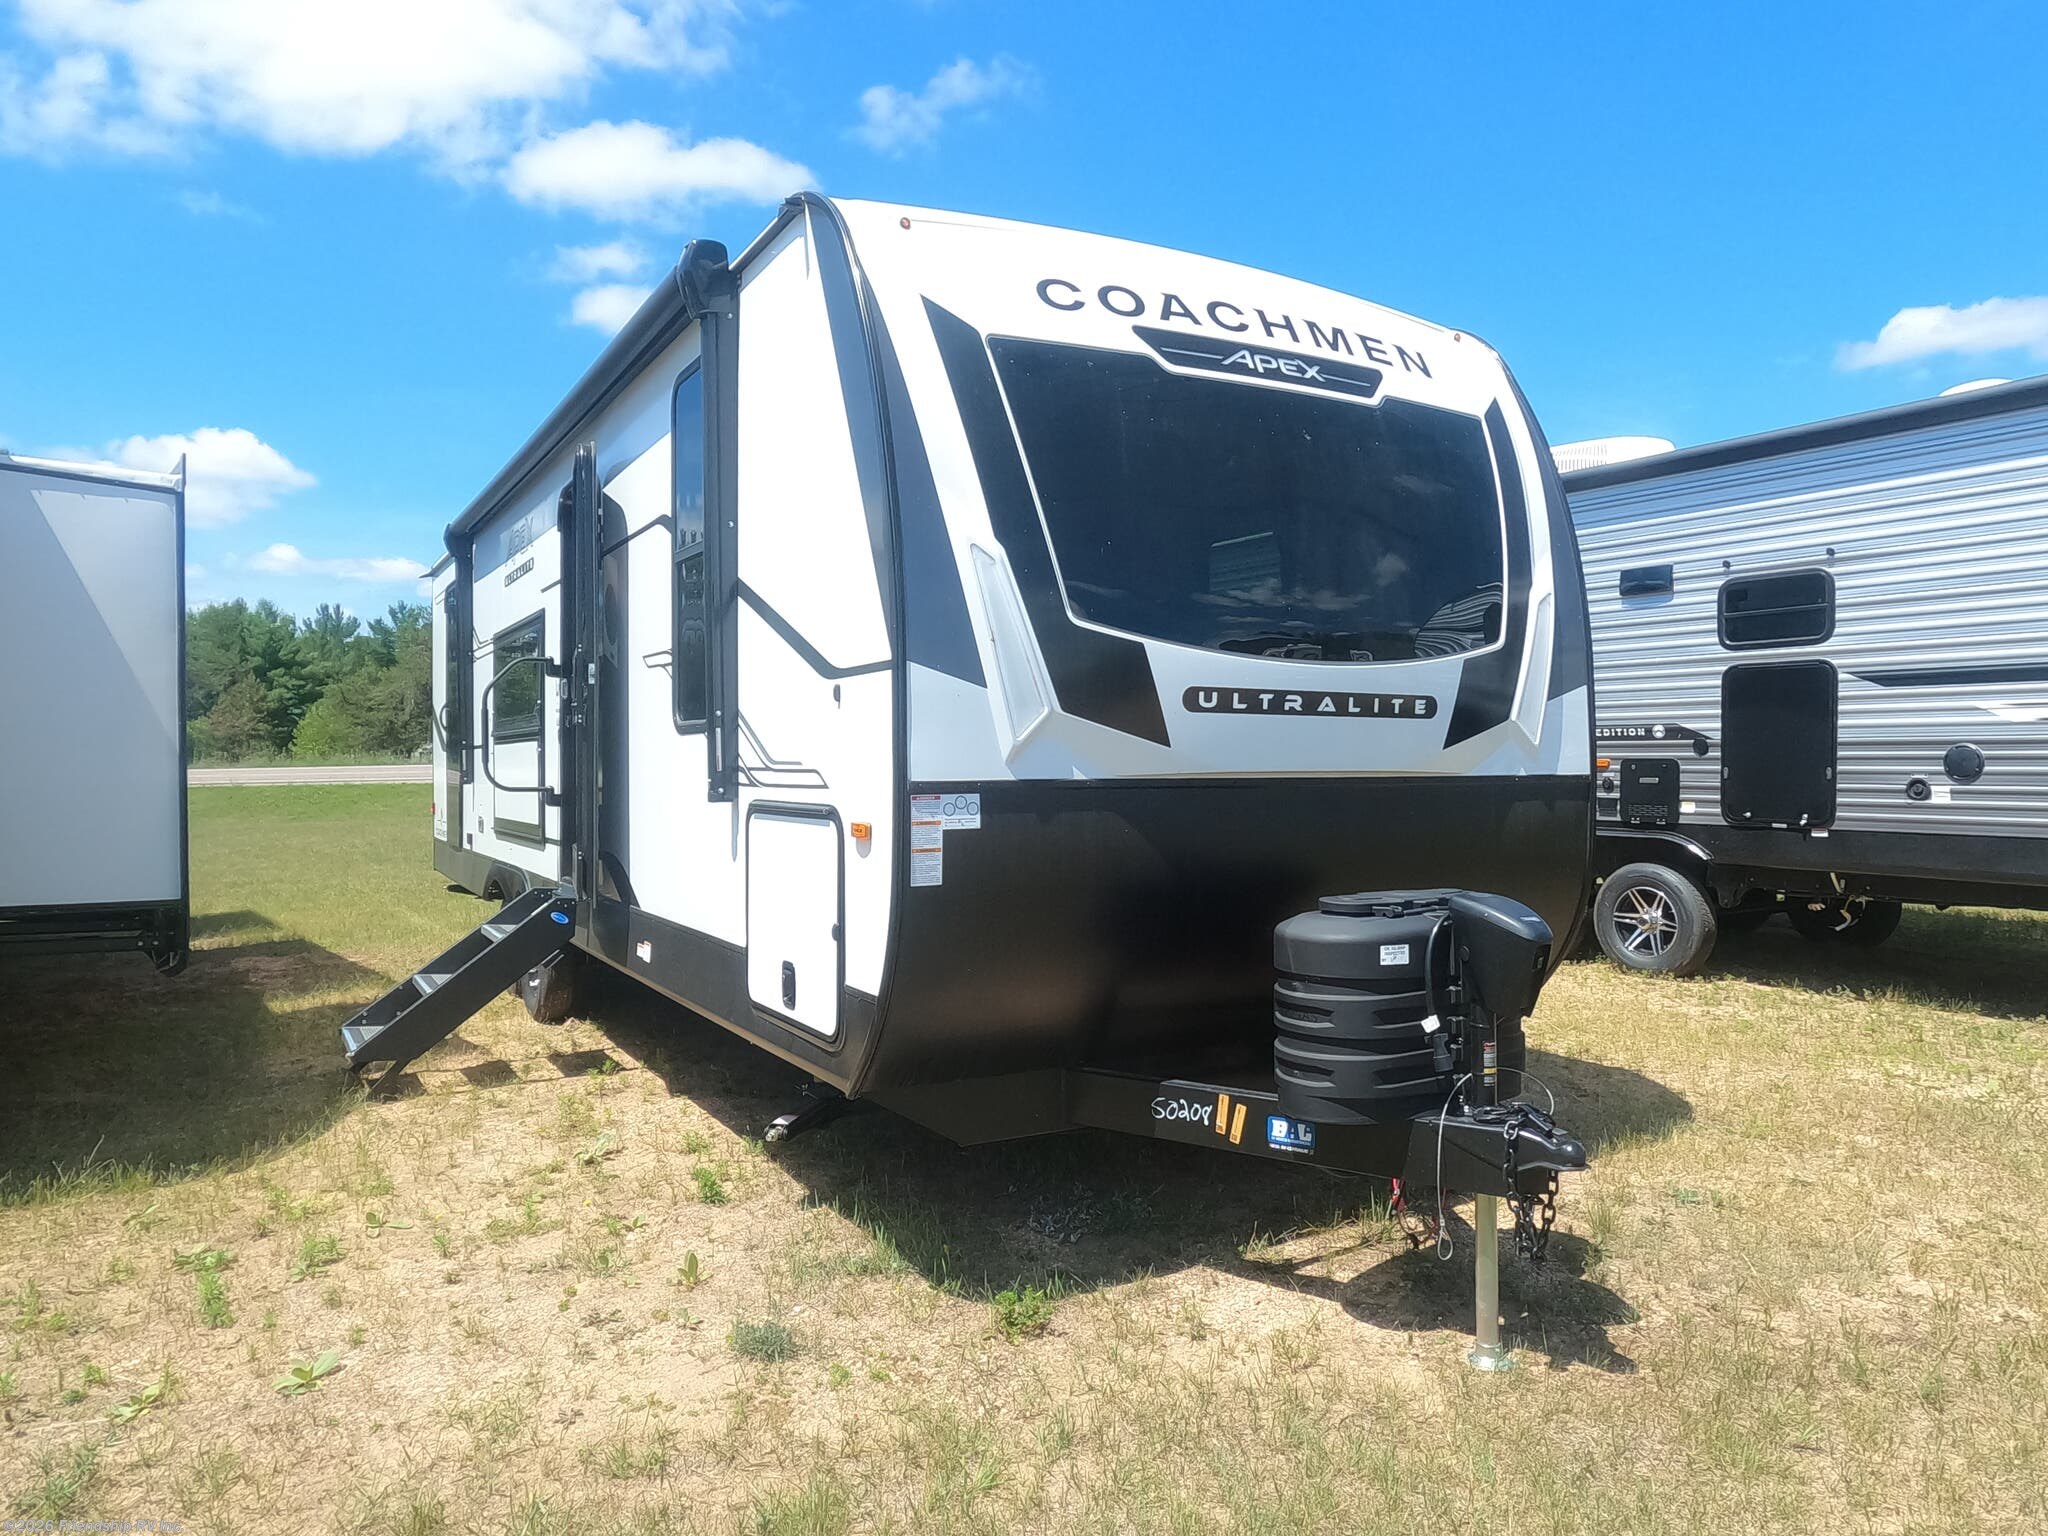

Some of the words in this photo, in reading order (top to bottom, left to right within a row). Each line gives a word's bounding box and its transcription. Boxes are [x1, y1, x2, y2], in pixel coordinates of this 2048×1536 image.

[1036, 278, 1433, 380] COACHMEN
[1221, 348, 1326, 382] APEX
[1198, 690, 1427, 715] ULTRALITE
